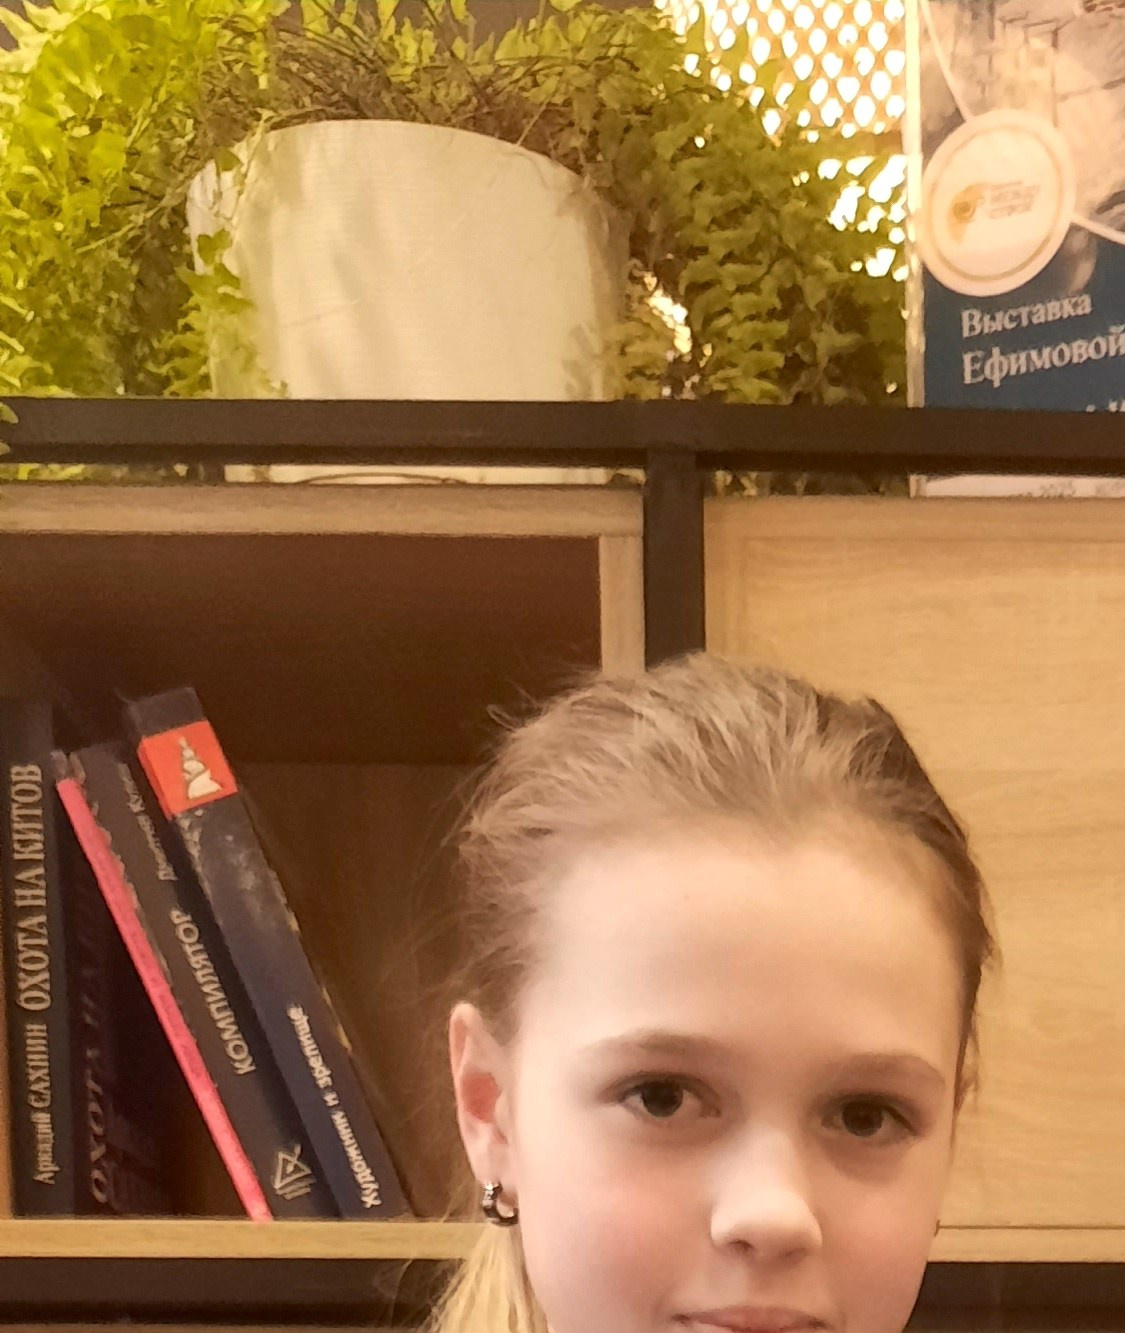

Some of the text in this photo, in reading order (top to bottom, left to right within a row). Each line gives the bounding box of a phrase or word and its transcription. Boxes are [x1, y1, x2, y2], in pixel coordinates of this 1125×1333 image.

[961, 293, 1092, 338] Выставка
[10, 764, 45, 860] КИТОВ
[15, 867, 47, 907] НА
[17, 914, 51, 1011] ОХОТА
[169, 907, 256, 1075] КОМПИЛЯТОР
[25, 1024, 50, 1108] САХНИН
[287, 1004, 333, 1088] зрелище
[331, 1110, 382, 1208] Художник
